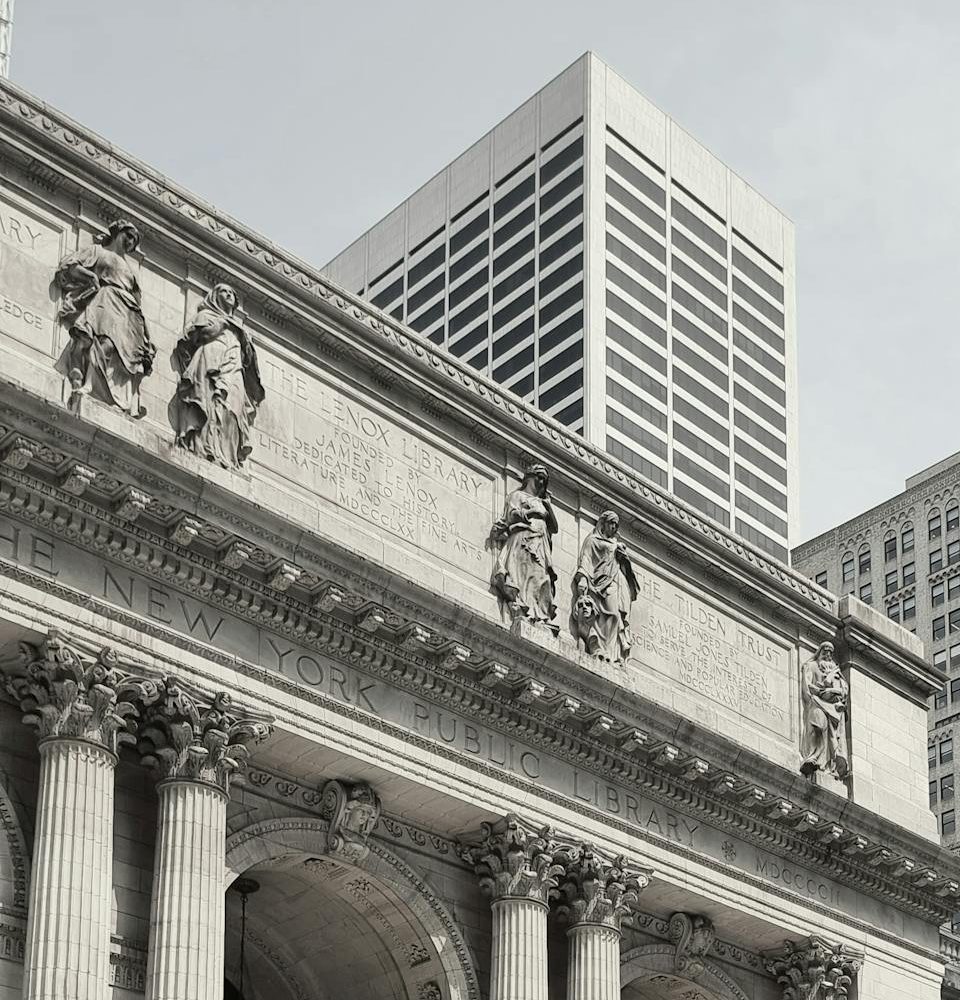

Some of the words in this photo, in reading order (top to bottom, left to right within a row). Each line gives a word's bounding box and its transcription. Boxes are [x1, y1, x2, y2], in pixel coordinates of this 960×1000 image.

[266, 361, 308, 402] THE
[319, 391, 391, 447] LENOX
[402, 438, 483, 498] LIBRARY
[334, 428, 394, 468] FOUNDED
[408, 469, 421, 482] BY
[259, 434, 345, 489] LITERATURE
[356, 488, 381, 507] AND
[390, 503, 413, 526] THE
[421, 520, 447, 544] FINE
[453, 539, 482, 561] ARTS
[294, 437, 367, 484] DEDICATED
[377, 481, 392, 498] TO
[316, 434, 371, 472] JAMES
[385, 470, 438, 509] LENOX
[649, 615, 692, 648] SAMUEL
[698, 642, 729, 669] JONES
[734, 661, 768, 689] TILDEN
[660, 635, 686, 657] SERVE
[691, 651, 709, 669] THE
[674, 657, 692, 673] AND
[675, 593, 726, 636] TILDEN
[738, 629, 781, 666] TRUST
[679, 619, 721, 649] FOUNDED
[103, 566, 225, 641] NEW
[268, 638, 377, 713] YORK
[410, 703, 541, 780] PUBLIC
[574, 770, 700, 847] LIBRARY
